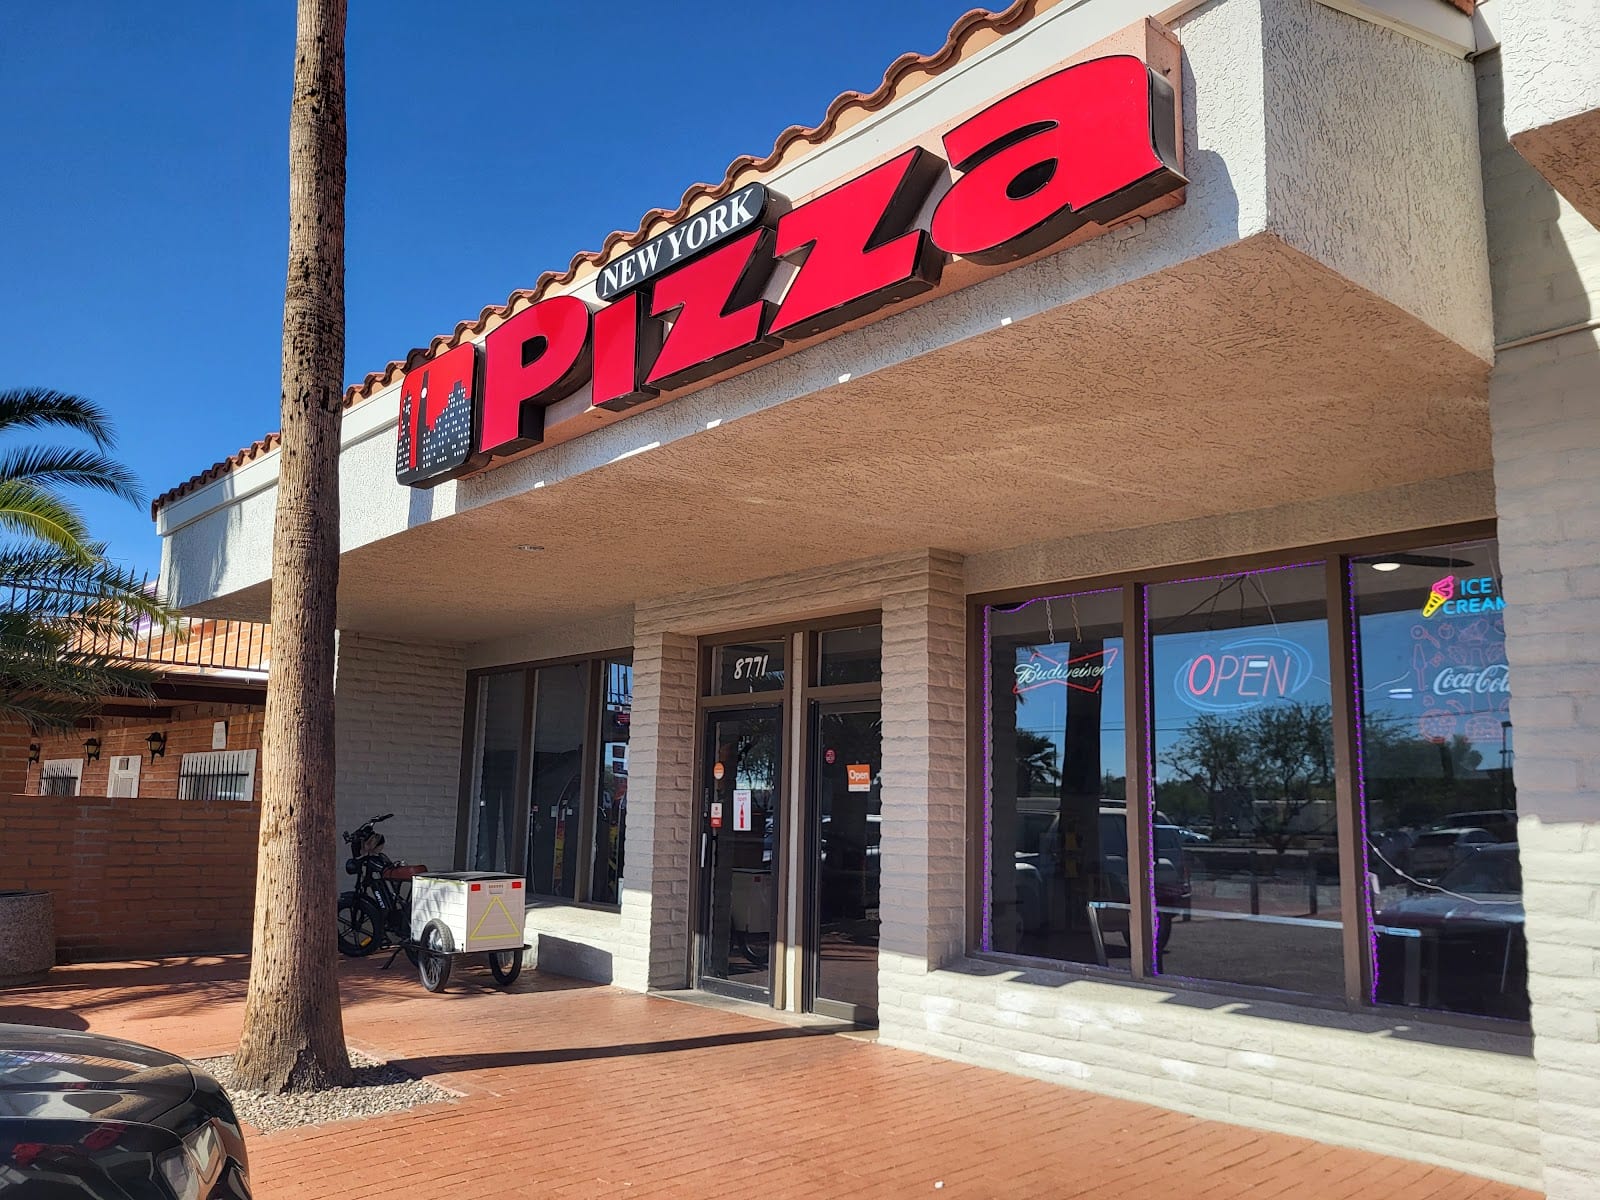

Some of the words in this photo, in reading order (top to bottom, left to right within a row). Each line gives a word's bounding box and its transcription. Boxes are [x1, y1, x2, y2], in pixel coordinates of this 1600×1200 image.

[601, 239, 662, 297] NEW
[667, 188, 754, 261] YORK
[1460, 577, 1493, 596] ICE
[733, 654, 769, 680] 8771
[1014, 662, 1112, 684] Budweiser
[1188, 654, 1291, 697] OPEN
[848, 769, 869, 782] Open
